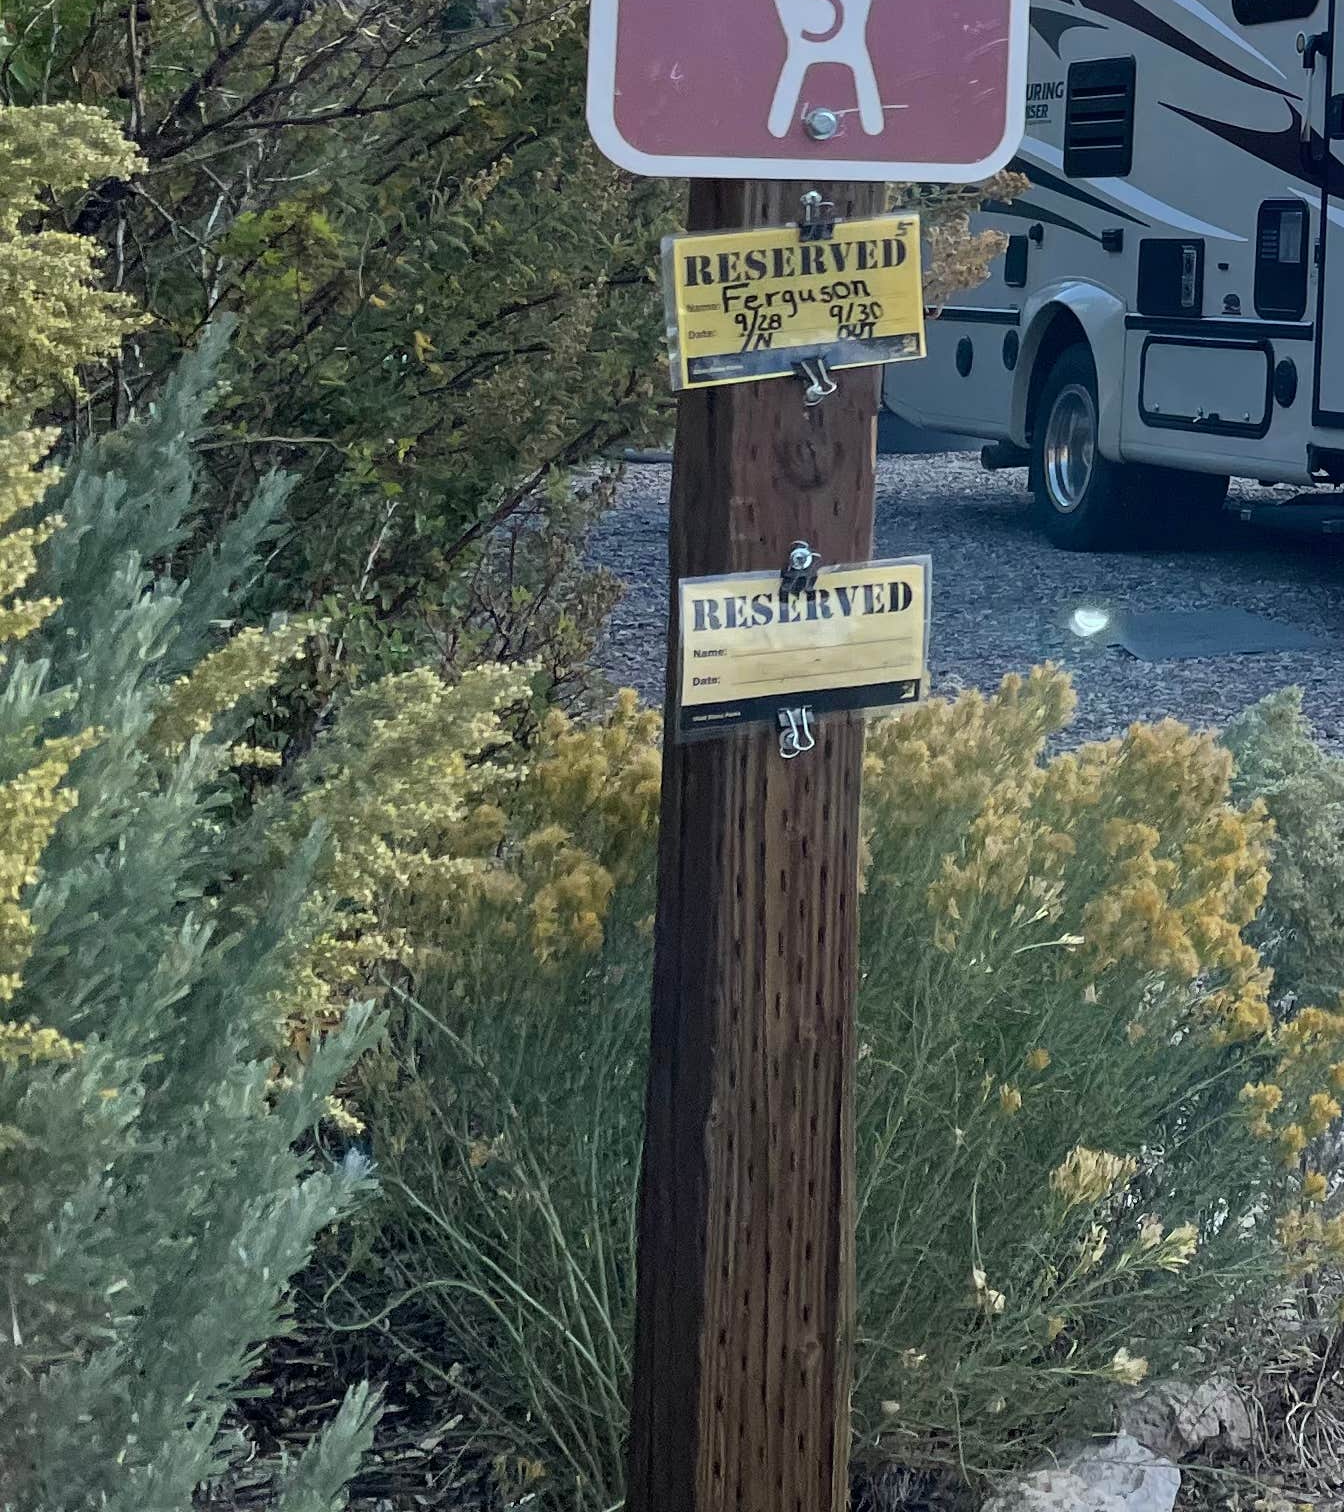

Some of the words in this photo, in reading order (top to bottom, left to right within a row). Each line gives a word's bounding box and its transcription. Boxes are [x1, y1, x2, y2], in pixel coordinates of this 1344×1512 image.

[1026, 81, 1065, 101] URING
[683, 238, 907, 287] RESERVED
[721, 280, 871, 318] Ferguson
[734, 311, 783, 338] 9/28
[829, 301, 883, 324] 9/30
[692, 581, 913, 632] RESERVED
[693, 648, 727, 658] Name:
[692, 676, 721, 686] Date:
